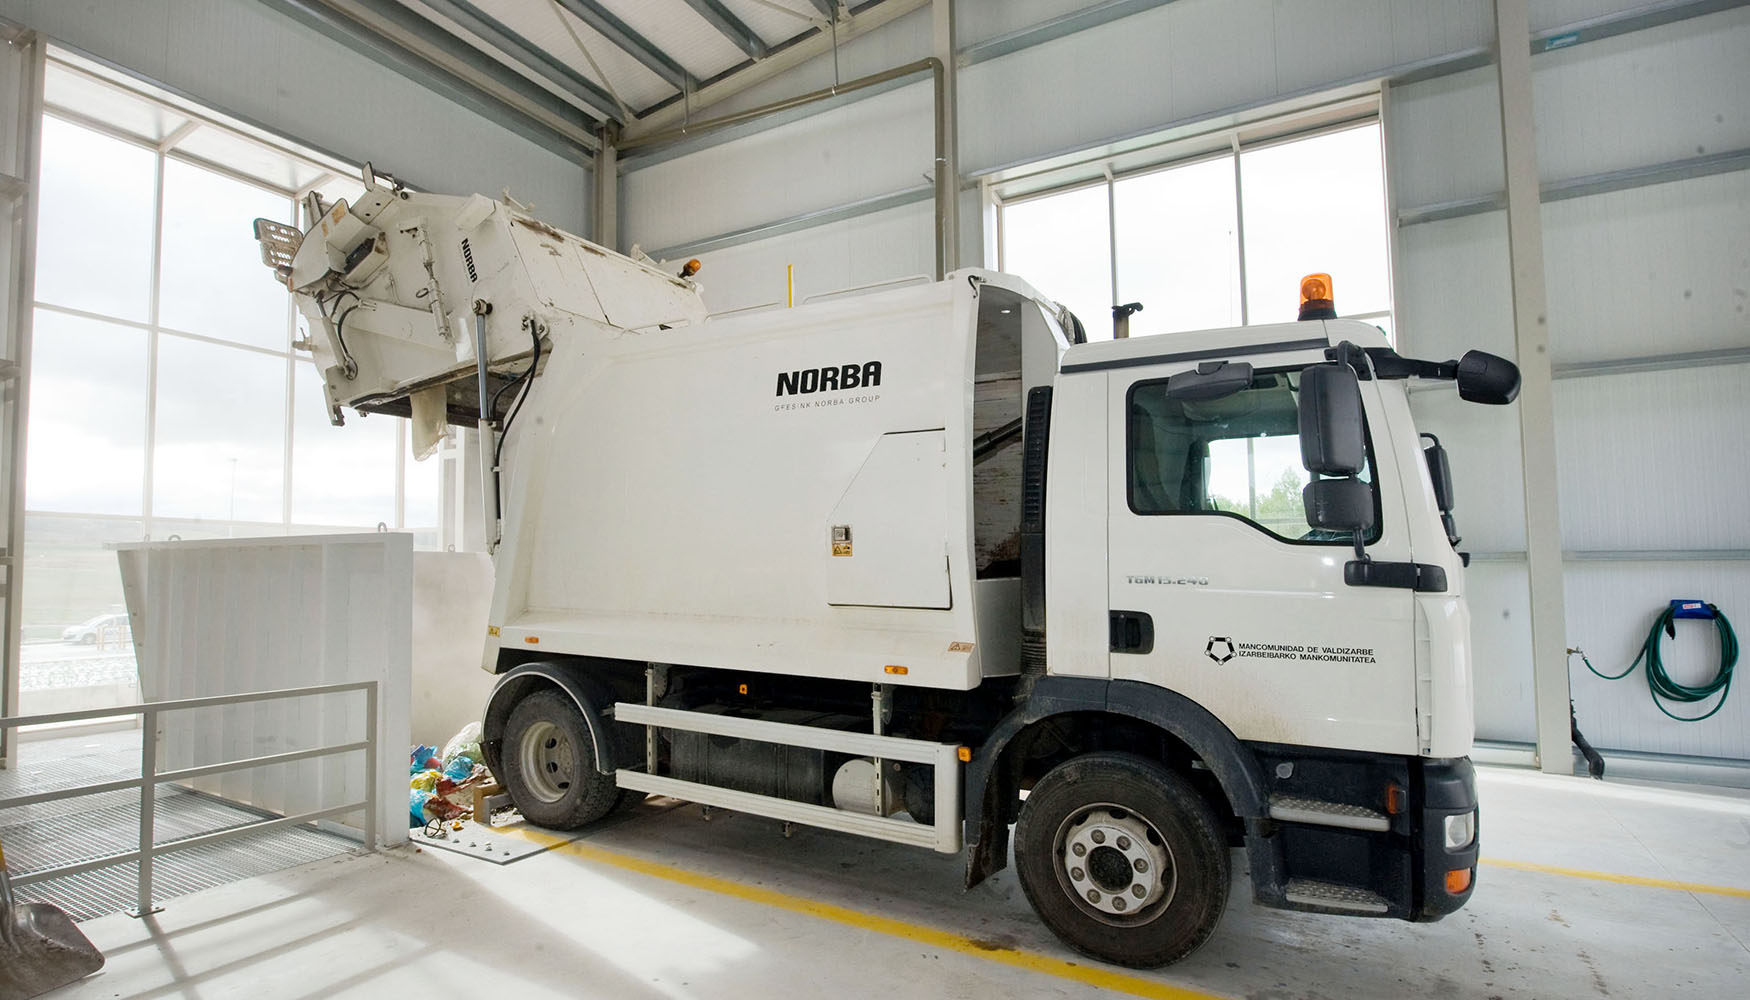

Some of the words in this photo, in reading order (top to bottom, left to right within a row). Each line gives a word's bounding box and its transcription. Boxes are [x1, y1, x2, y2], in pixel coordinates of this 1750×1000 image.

[461, 238, 478, 283] NORBA
[776, 361, 882, 396] NORBA
[815, 399, 844, 408] NORBA
[848, 395, 880, 404] GROUP
[1238, 643, 1304, 653] MANCOMUNIDAD
[1322, 647, 1374, 656] VALDIZARBE
[1238, 650, 1297, 660] IZARBEIBARKO
[1299, 653, 1376, 664] MANKOMUNITATEA
